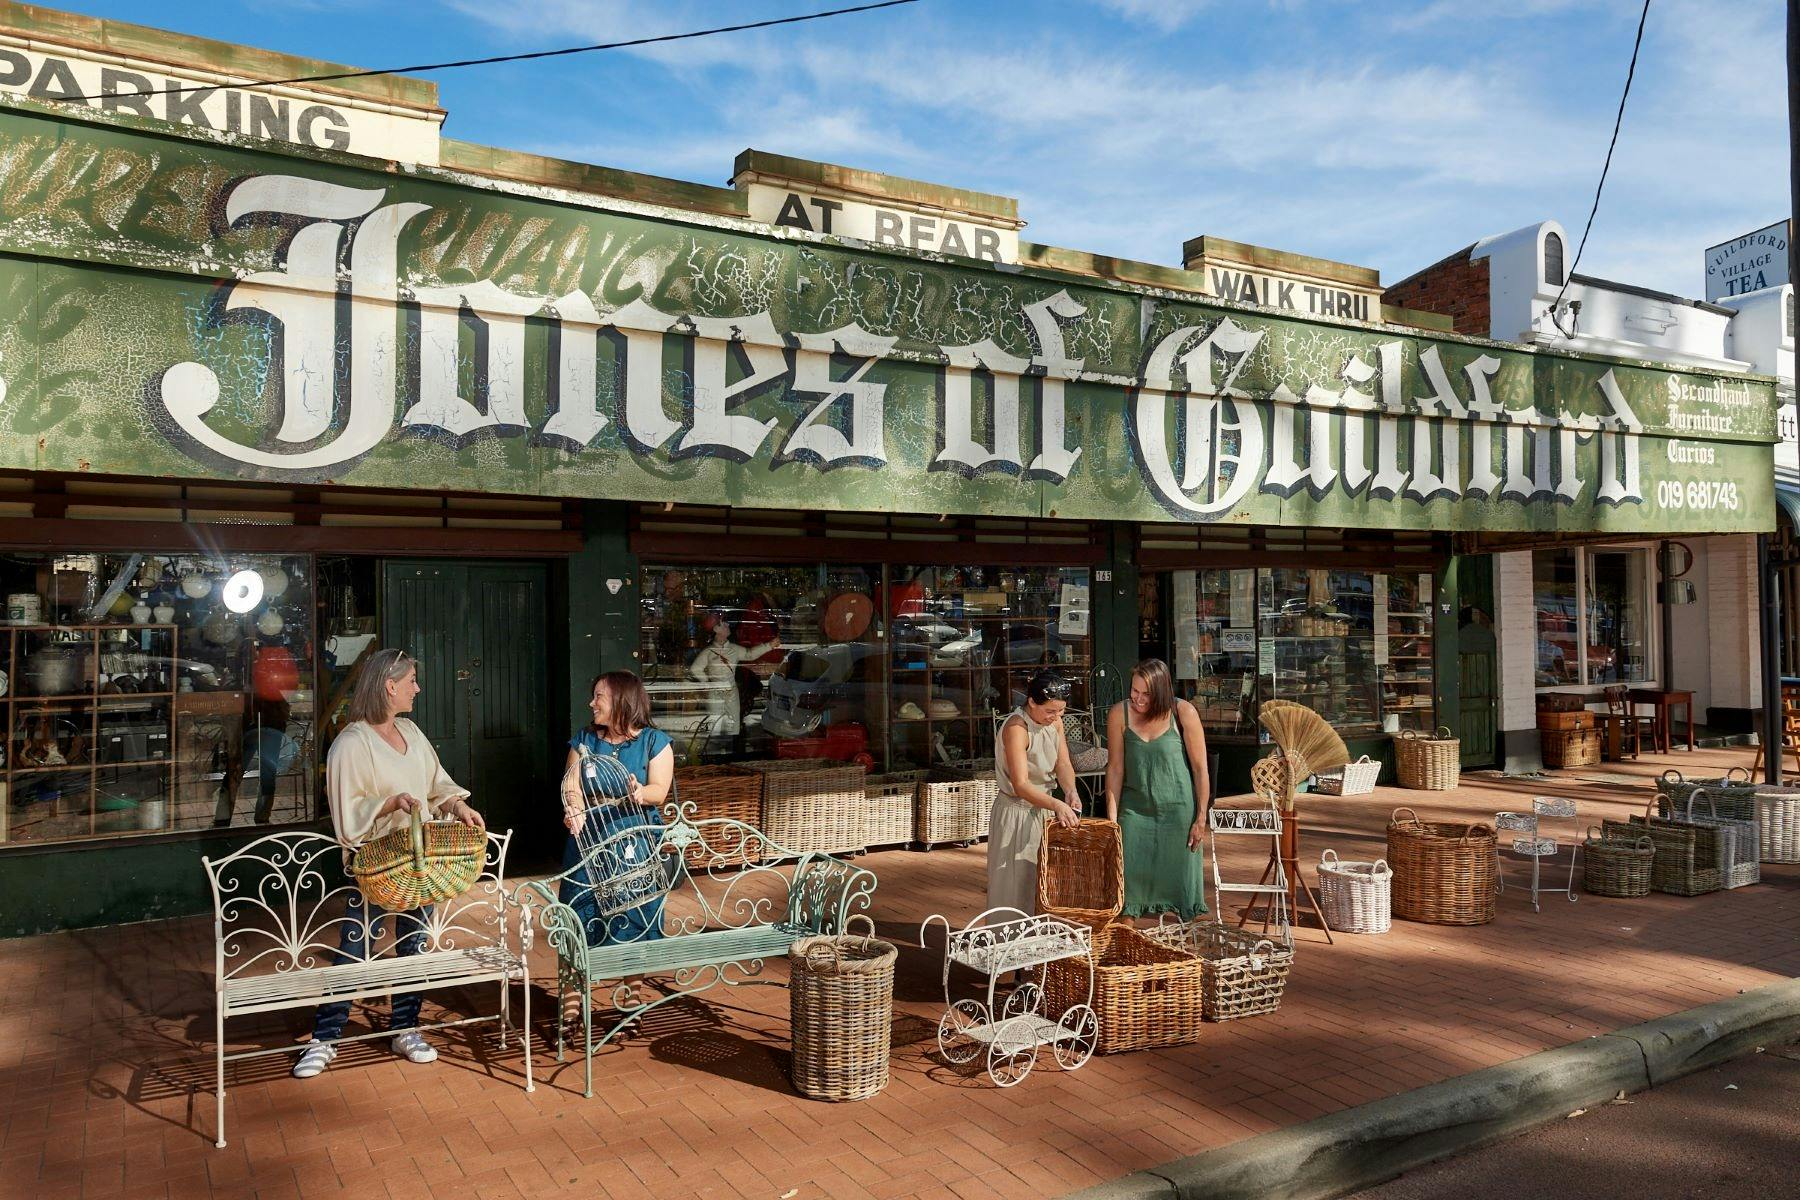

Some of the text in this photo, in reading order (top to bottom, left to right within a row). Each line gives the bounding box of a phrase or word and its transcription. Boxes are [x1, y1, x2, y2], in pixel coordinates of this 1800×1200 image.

[0, 50, 351, 152] PARKING
[774, 193, 1003, 264] AT REAR
[1707, 234, 1787, 276] GUILDFORD
[1721, 253, 1772, 279] VILLAGE
[1211, 267, 1369, 321] WALK THRU
[1725, 270, 1768, 297] TEA
[160, 174, 890, 470] Jones
[932, 289, 1087, 480] of
[1132, 314, 1644, 514] Guildford
[1667, 374, 1751, 410] Secondhand
[1666, 403, 1733, 433] Furniture
[1667, 439, 1715, 465] Curios
[1657, 480, 1738, 510] 019 681743
[1096, 571, 1111, 581] 165
